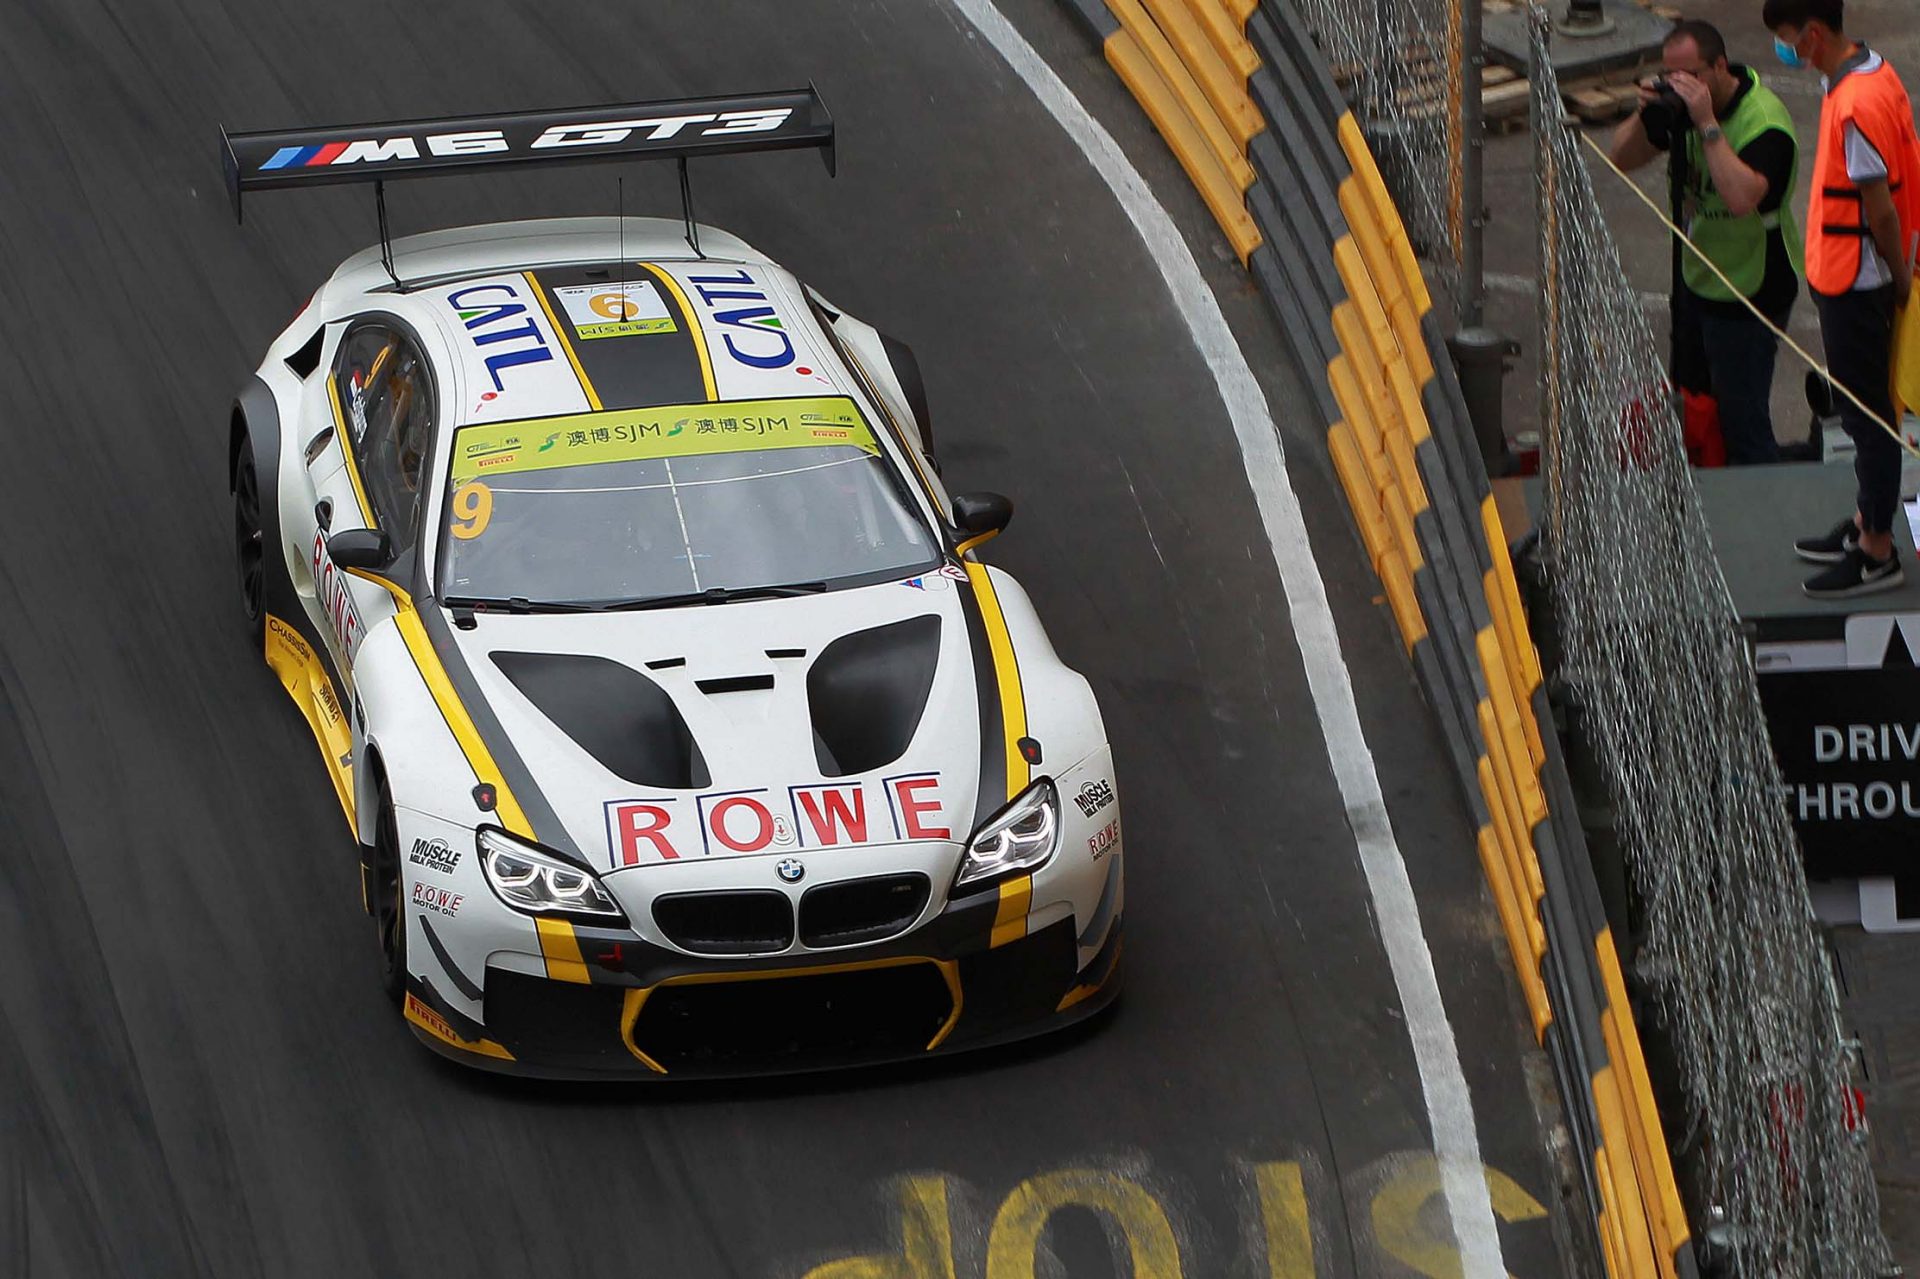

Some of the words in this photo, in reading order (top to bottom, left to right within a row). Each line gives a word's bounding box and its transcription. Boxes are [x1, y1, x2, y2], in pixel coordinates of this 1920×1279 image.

[331, 130, 509, 166] M6
[530, 107, 794, 150] GT3
[446, 284, 554, 393] CATL
[687, 269, 796, 369] CATL
[450, 482, 493, 540] 9
[1813, 723, 1920, 763] DRIV
[1073, 779, 1111, 810] MUSCLE
[617, 778, 951, 866] ROWE
[1089, 820, 1119, 855] ROWE
[409, 853, 426, 866] MILK
[426, 856, 455, 875] PROTEIN
[411, 838, 462, 866] MUSCLE
[412, 897, 440, 912] MOTOR
[441, 907, 456, 918] OIL
[413, 883, 463, 911] ROWE
[409, 995, 457, 1041] PIRELLI
